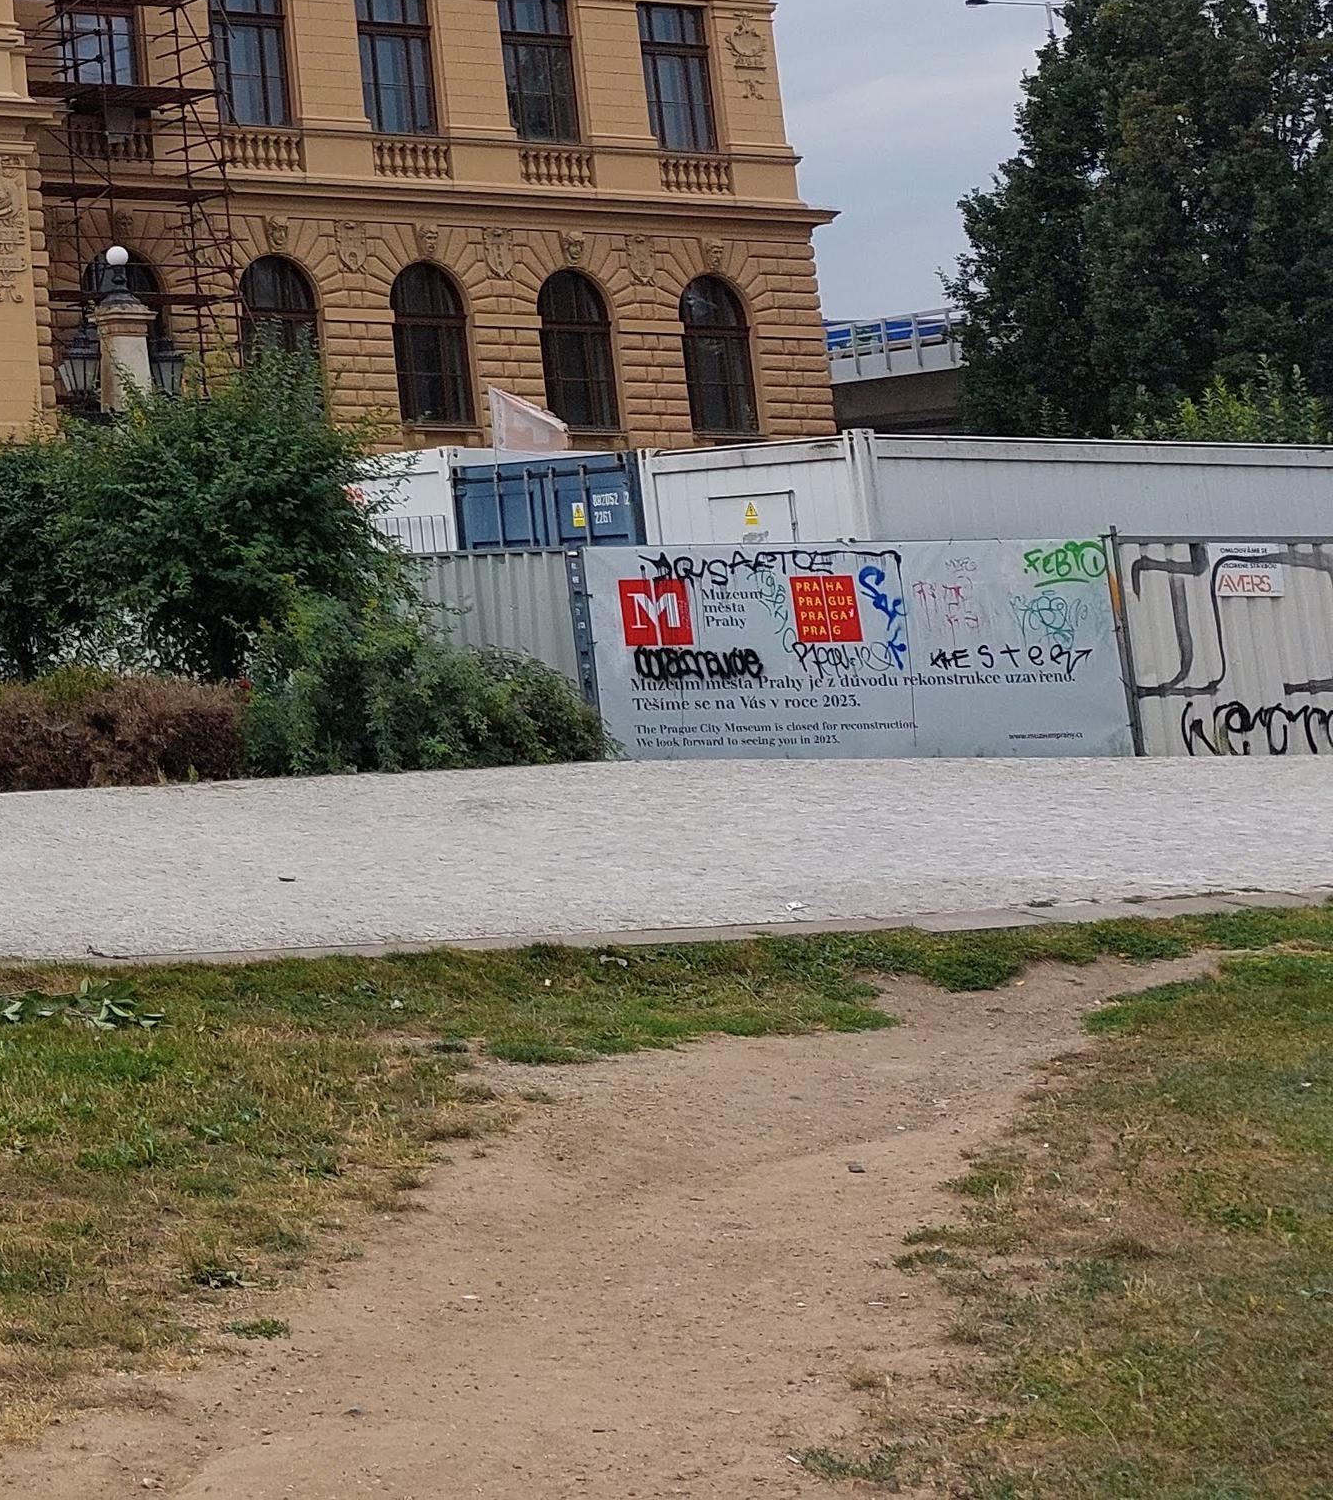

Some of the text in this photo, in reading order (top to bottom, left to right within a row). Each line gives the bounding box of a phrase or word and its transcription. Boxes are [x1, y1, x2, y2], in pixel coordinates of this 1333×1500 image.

[701, 588, 763, 601] Muzeum
[703, 601, 745, 613] města
[705, 615, 747, 629] Prahy
[631, 677, 701, 691] Muzeum
[758, 675, 804, 692] Prahy
[807, 676, 822, 691] je
[827, 678, 836, 688] z
[840, 672, 898, 688] důvodu
[903, 671, 1001, 687] rekonstrukce
[632, 696, 691, 711] Těšíme
[694, 700, 712, 710] se
[715, 699, 735, 710] na
[739, 694, 767, 709] Vás
[771, 698, 781, 709] v
[785, 697, 819, 708] roce
[635, 723, 658, 735] The
[659, 723, 698, 736] Prague
[700, 722, 721, 734] City
[724, 721, 772, 733] Museum
[775, 721, 784, 732] is
[786, 721, 820, 732] closed
[822, 720, 839, 731] for
[635, 737, 654, 748] We
[656, 736, 681, 748] look
[682, 735, 724, 747] forward
[727, 736, 738, 746] to
[740, 735, 776, 747] seeing
[778, 736, 798, 747] you
[800, 735, 811, 745] in
